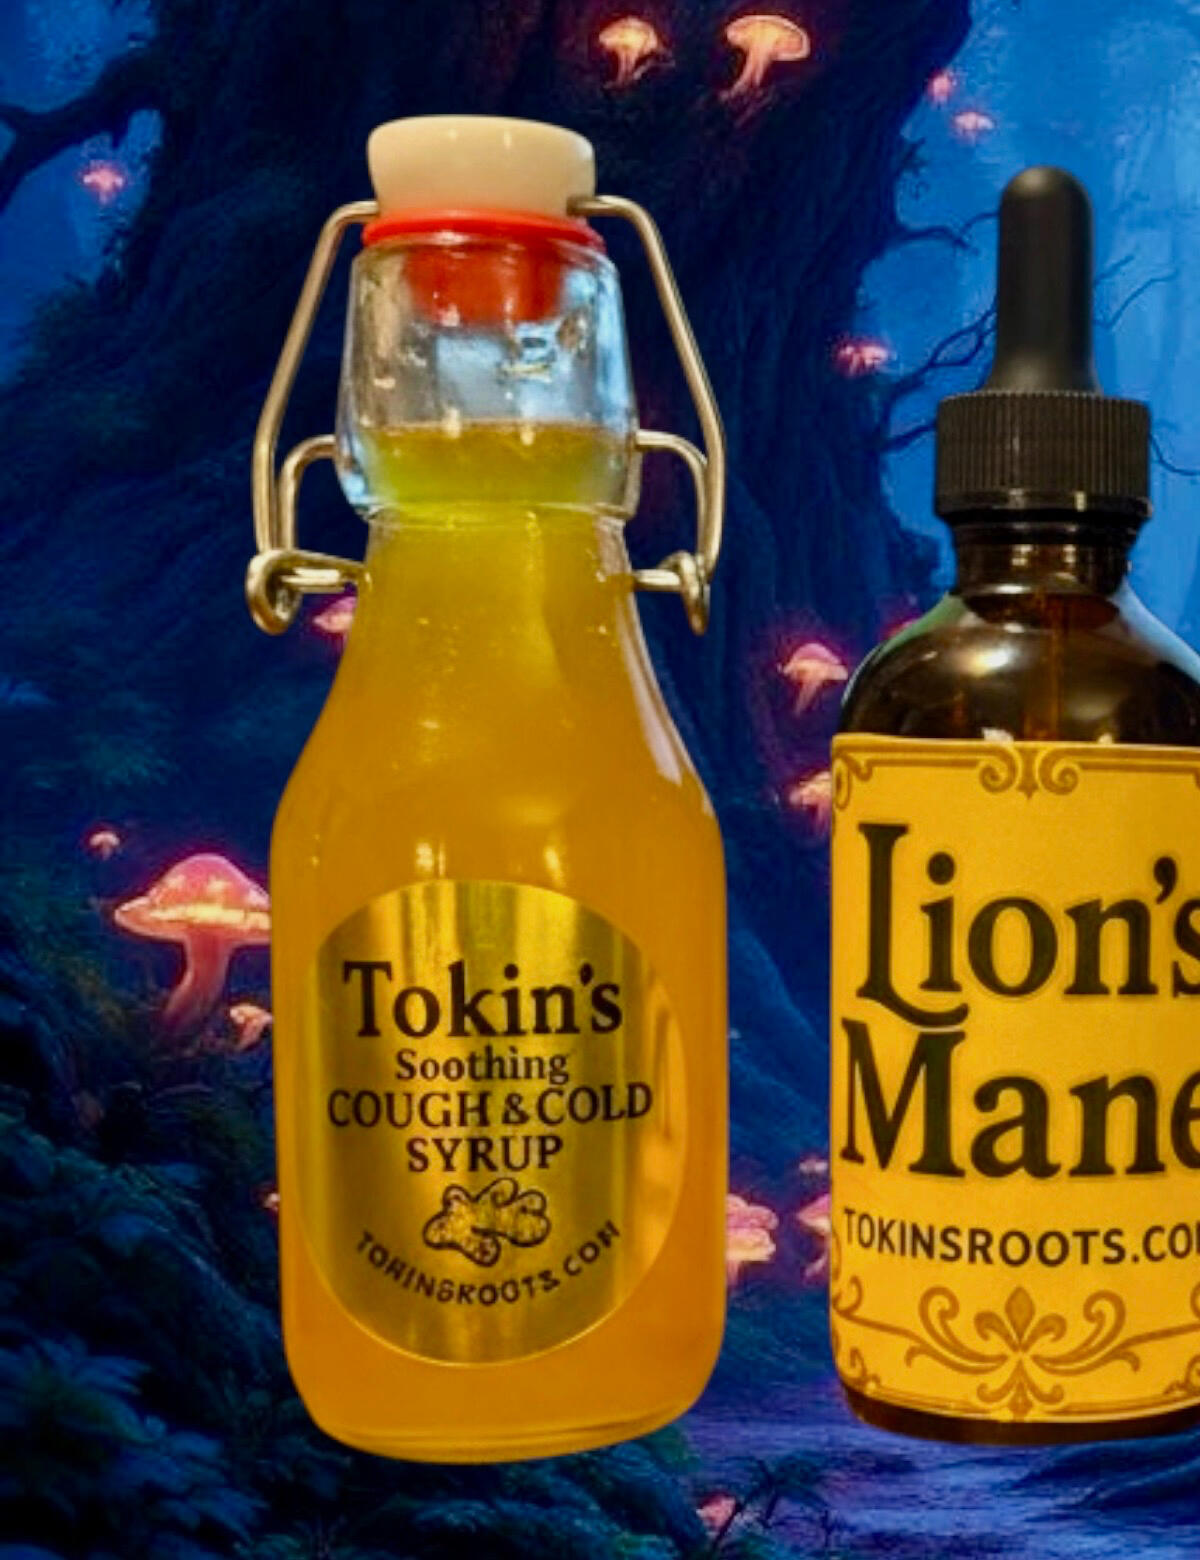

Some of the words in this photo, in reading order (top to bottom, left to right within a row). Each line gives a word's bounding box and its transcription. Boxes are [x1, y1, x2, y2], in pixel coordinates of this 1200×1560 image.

[343, 960, 623, 1037] Tokin's
[395, 1045, 569, 1084] Soothing
[327, 1090, 490, 1128] COUGH
[502, 1094, 530, 1127] &
[537, 1082, 654, 1126] COLD
[407, 1135, 563, 1172] SYRUP
